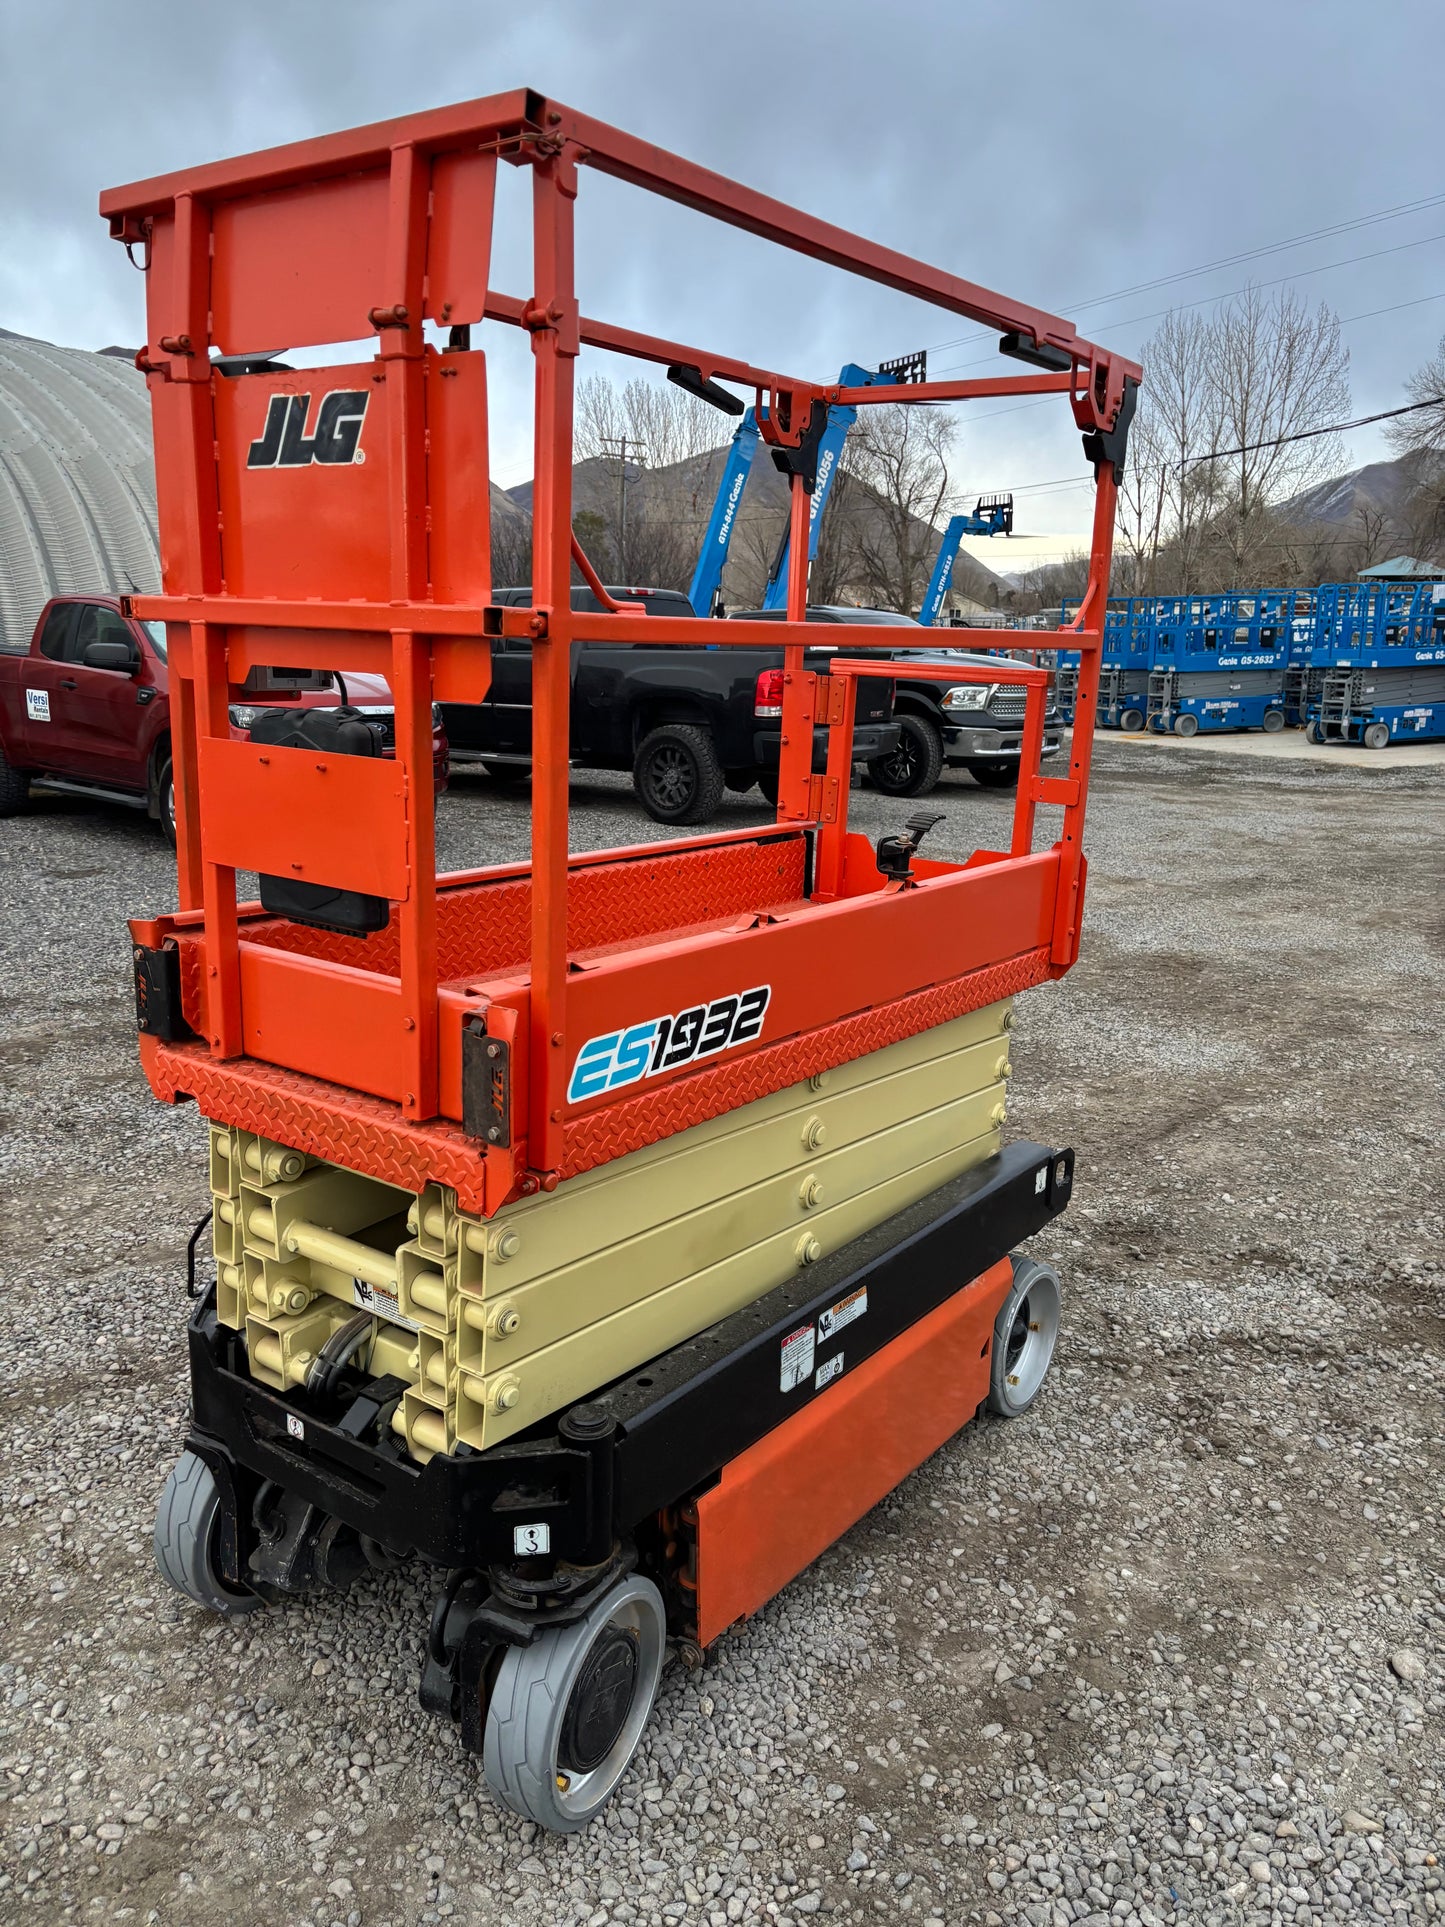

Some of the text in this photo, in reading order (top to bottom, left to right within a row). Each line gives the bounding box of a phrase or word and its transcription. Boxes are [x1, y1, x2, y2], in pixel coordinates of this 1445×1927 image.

[247, 390, 369, 466] JLG
[718, 472, 745, 544] GTH-844 Genie
[809, 449, 834, 519] GTH-1056
[1218, 655, 1275, 666] Genie GS-2632
[1415, 651, 1433, 660] Genie
[28, 691, 48, 705] Versi
[569, 986, 770, 1101] ES1932
